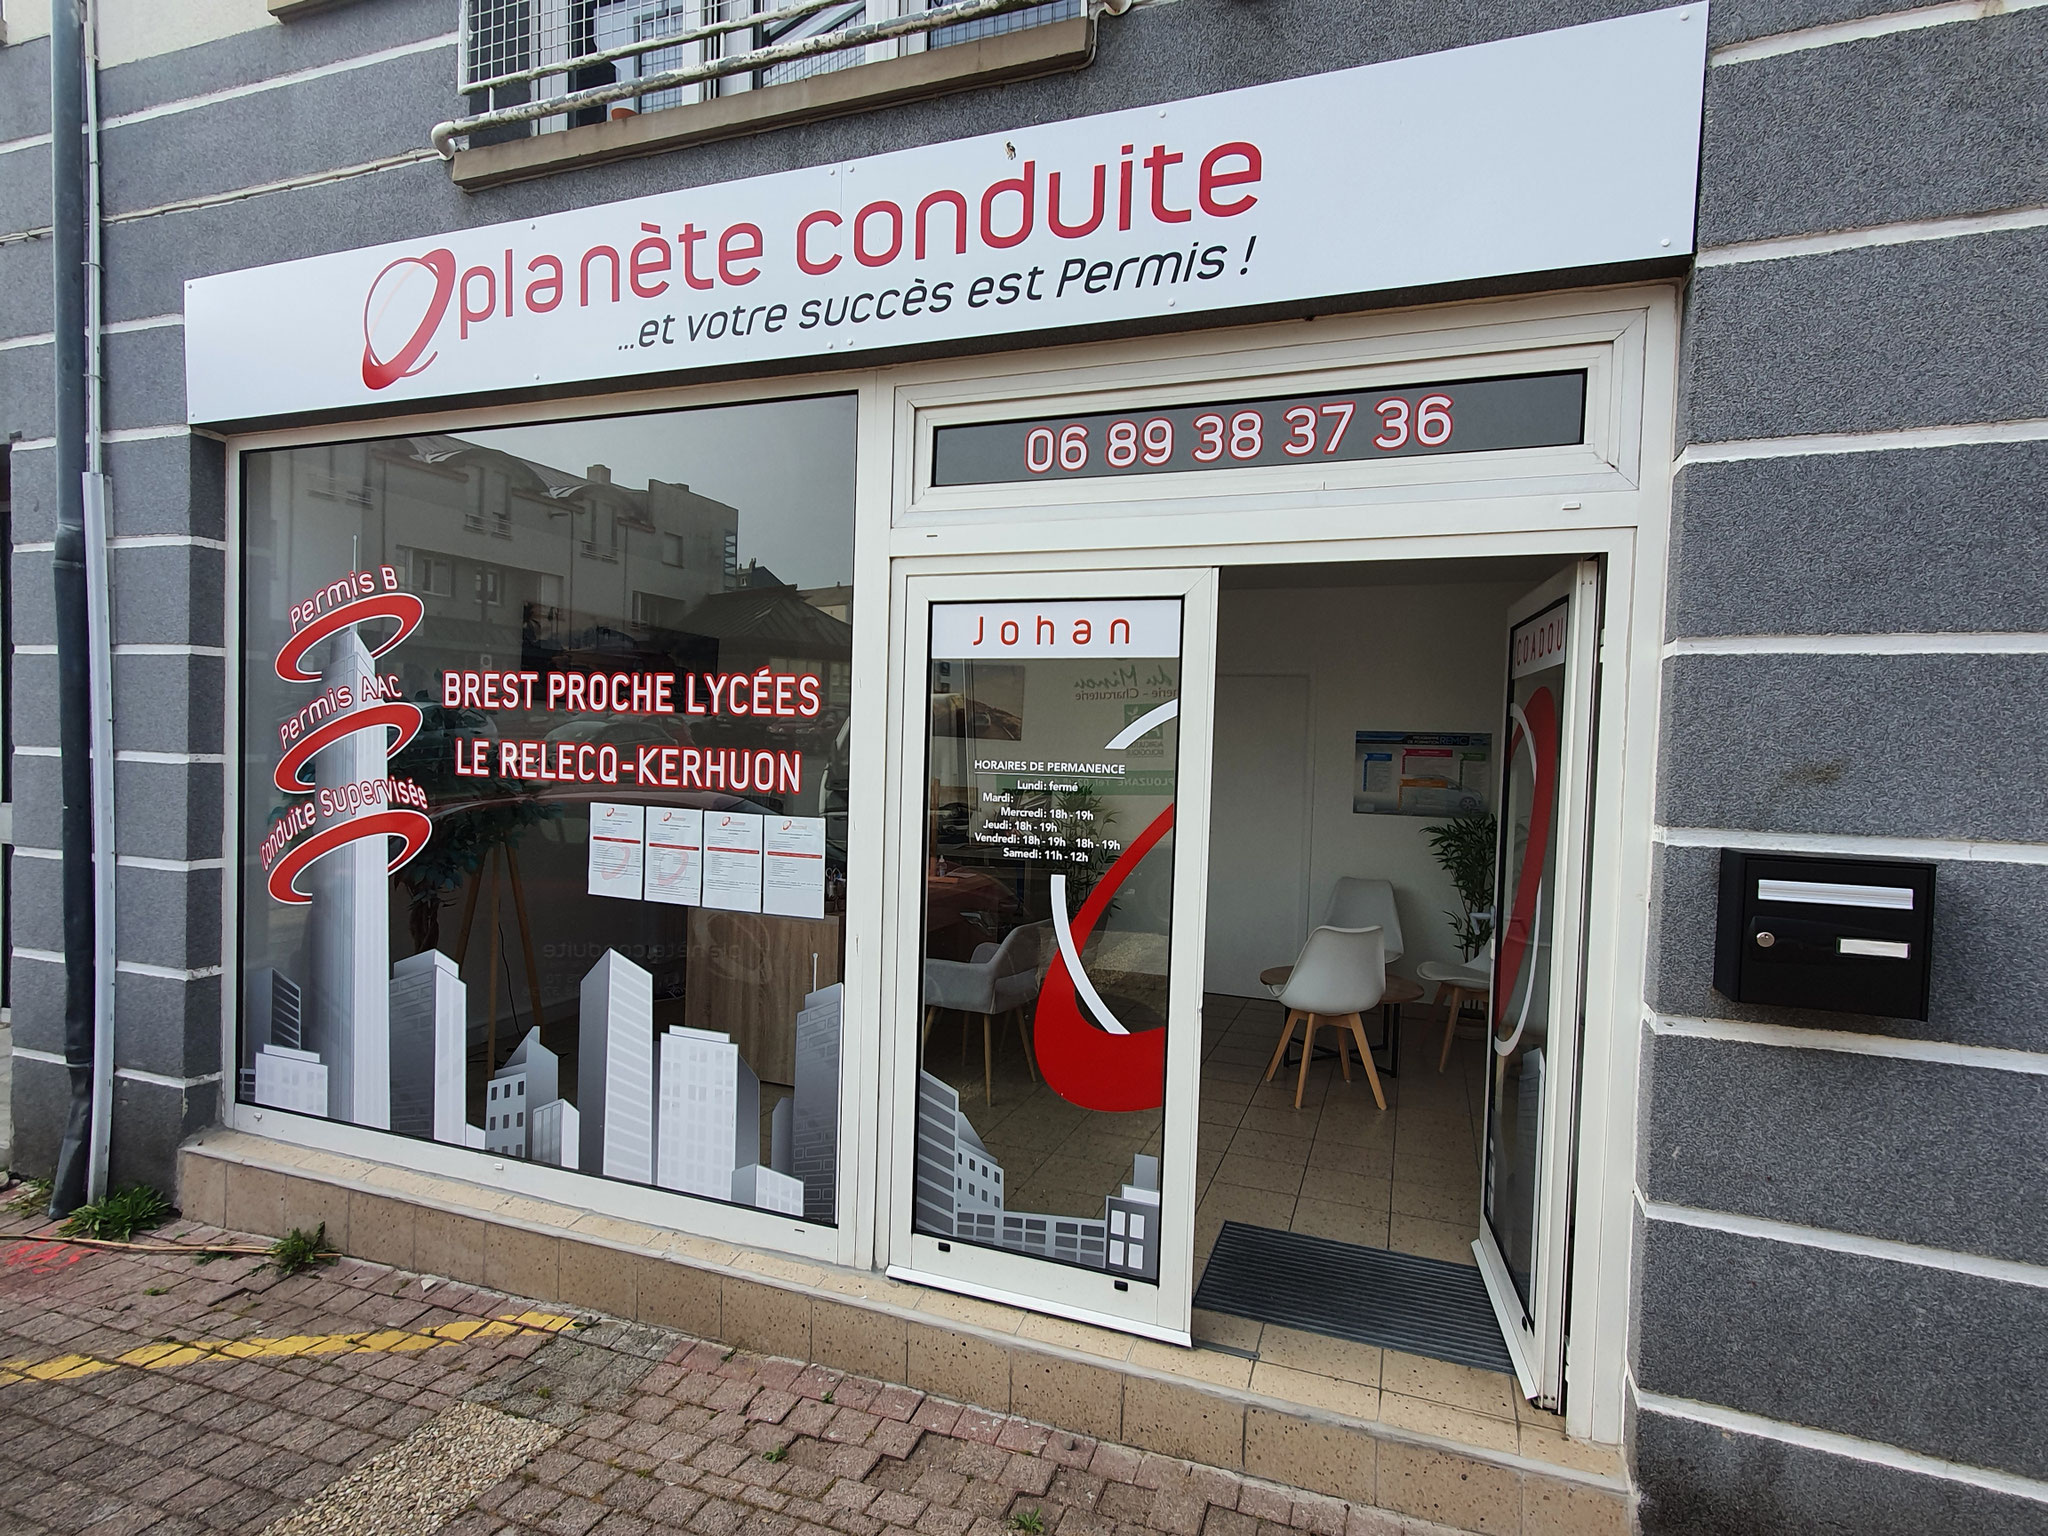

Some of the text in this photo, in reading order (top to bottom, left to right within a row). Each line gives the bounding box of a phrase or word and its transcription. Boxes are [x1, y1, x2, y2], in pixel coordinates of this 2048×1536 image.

[459, 141, 1262, 340] planète conduite
[687, 303, 786, 342] votre
[799, 278, 954, 329] succès
[967, 266, 1044, 308] est
[1056, 242, 1228, 298] Permis
[1240, 236, 1257, 275] !
[1024, 393, 1455, 473] 06 89 38 37 36
[289, 565, 399, 634] Permis B
[972, 614, 1131, 646] Johan
[1516, 617, 1564, 667] COADOU
[278, 674, 402, 750] Permis AAC
[442, 665, 822, 718] BREST PROCHE LYCÉES
[455, 737, 802, 794] LE RELECQ-KERHUON
[974, 760, 1125, 775] HORAIRES DE PERMANENCE
[1049, 781, 1078, 792] fermé
[319, 776, 428, 816] Supervisée
[1049, 809, 1068, 819] 18h
[1075, 810, 1094, 820] 19h
[1014, 821, 1032, 831] 18h
[1040, 822, 1057, 832] 19h
[1022, 835, 1040, 845] 18h
[1048, 836, 1066, 847] 19h
[1076, 838, 1094, 848] 18h
[1102, 840, 1120, 850] 19h
[1045, 850, 1063, 861] 11h
[1070, 852, 1088, 862] 12h
